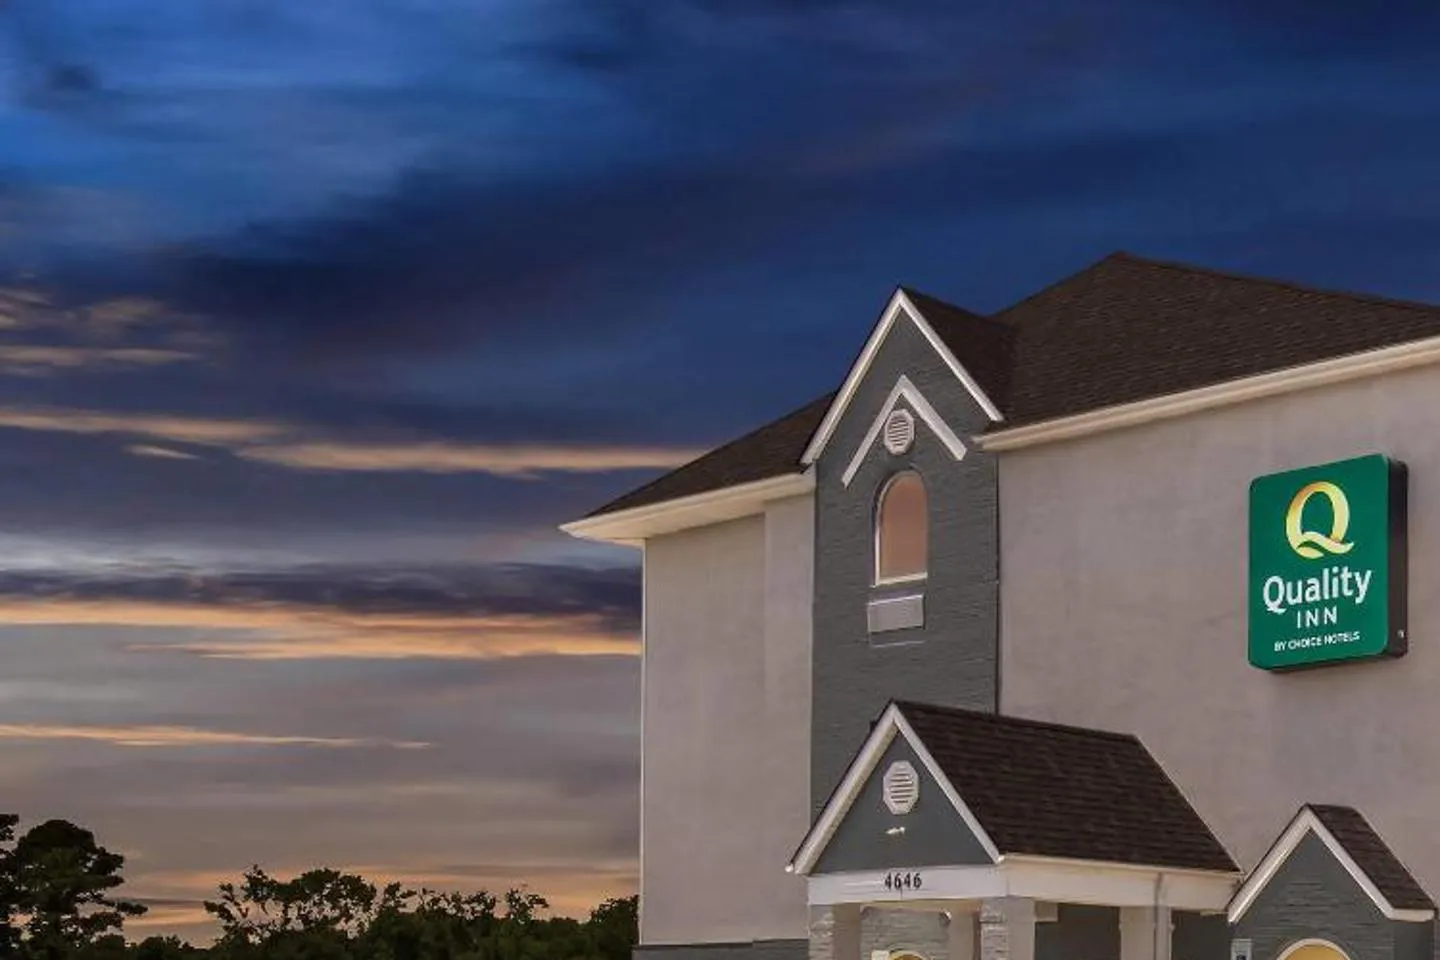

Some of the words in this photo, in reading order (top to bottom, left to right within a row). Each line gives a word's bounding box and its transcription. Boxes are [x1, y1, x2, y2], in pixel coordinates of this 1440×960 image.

[1286, 481, 1354, 559] Q
[1263, 566, 1372, 614] Quality
[1297, 606, 1338, 629] INN
[1274, 640, 1287, 652] BY
[1288, 636, 1322, 650] CHOICE
[1324, 631, 1360, 645] HOTELS
[884, 872, 922, 890] 4646
